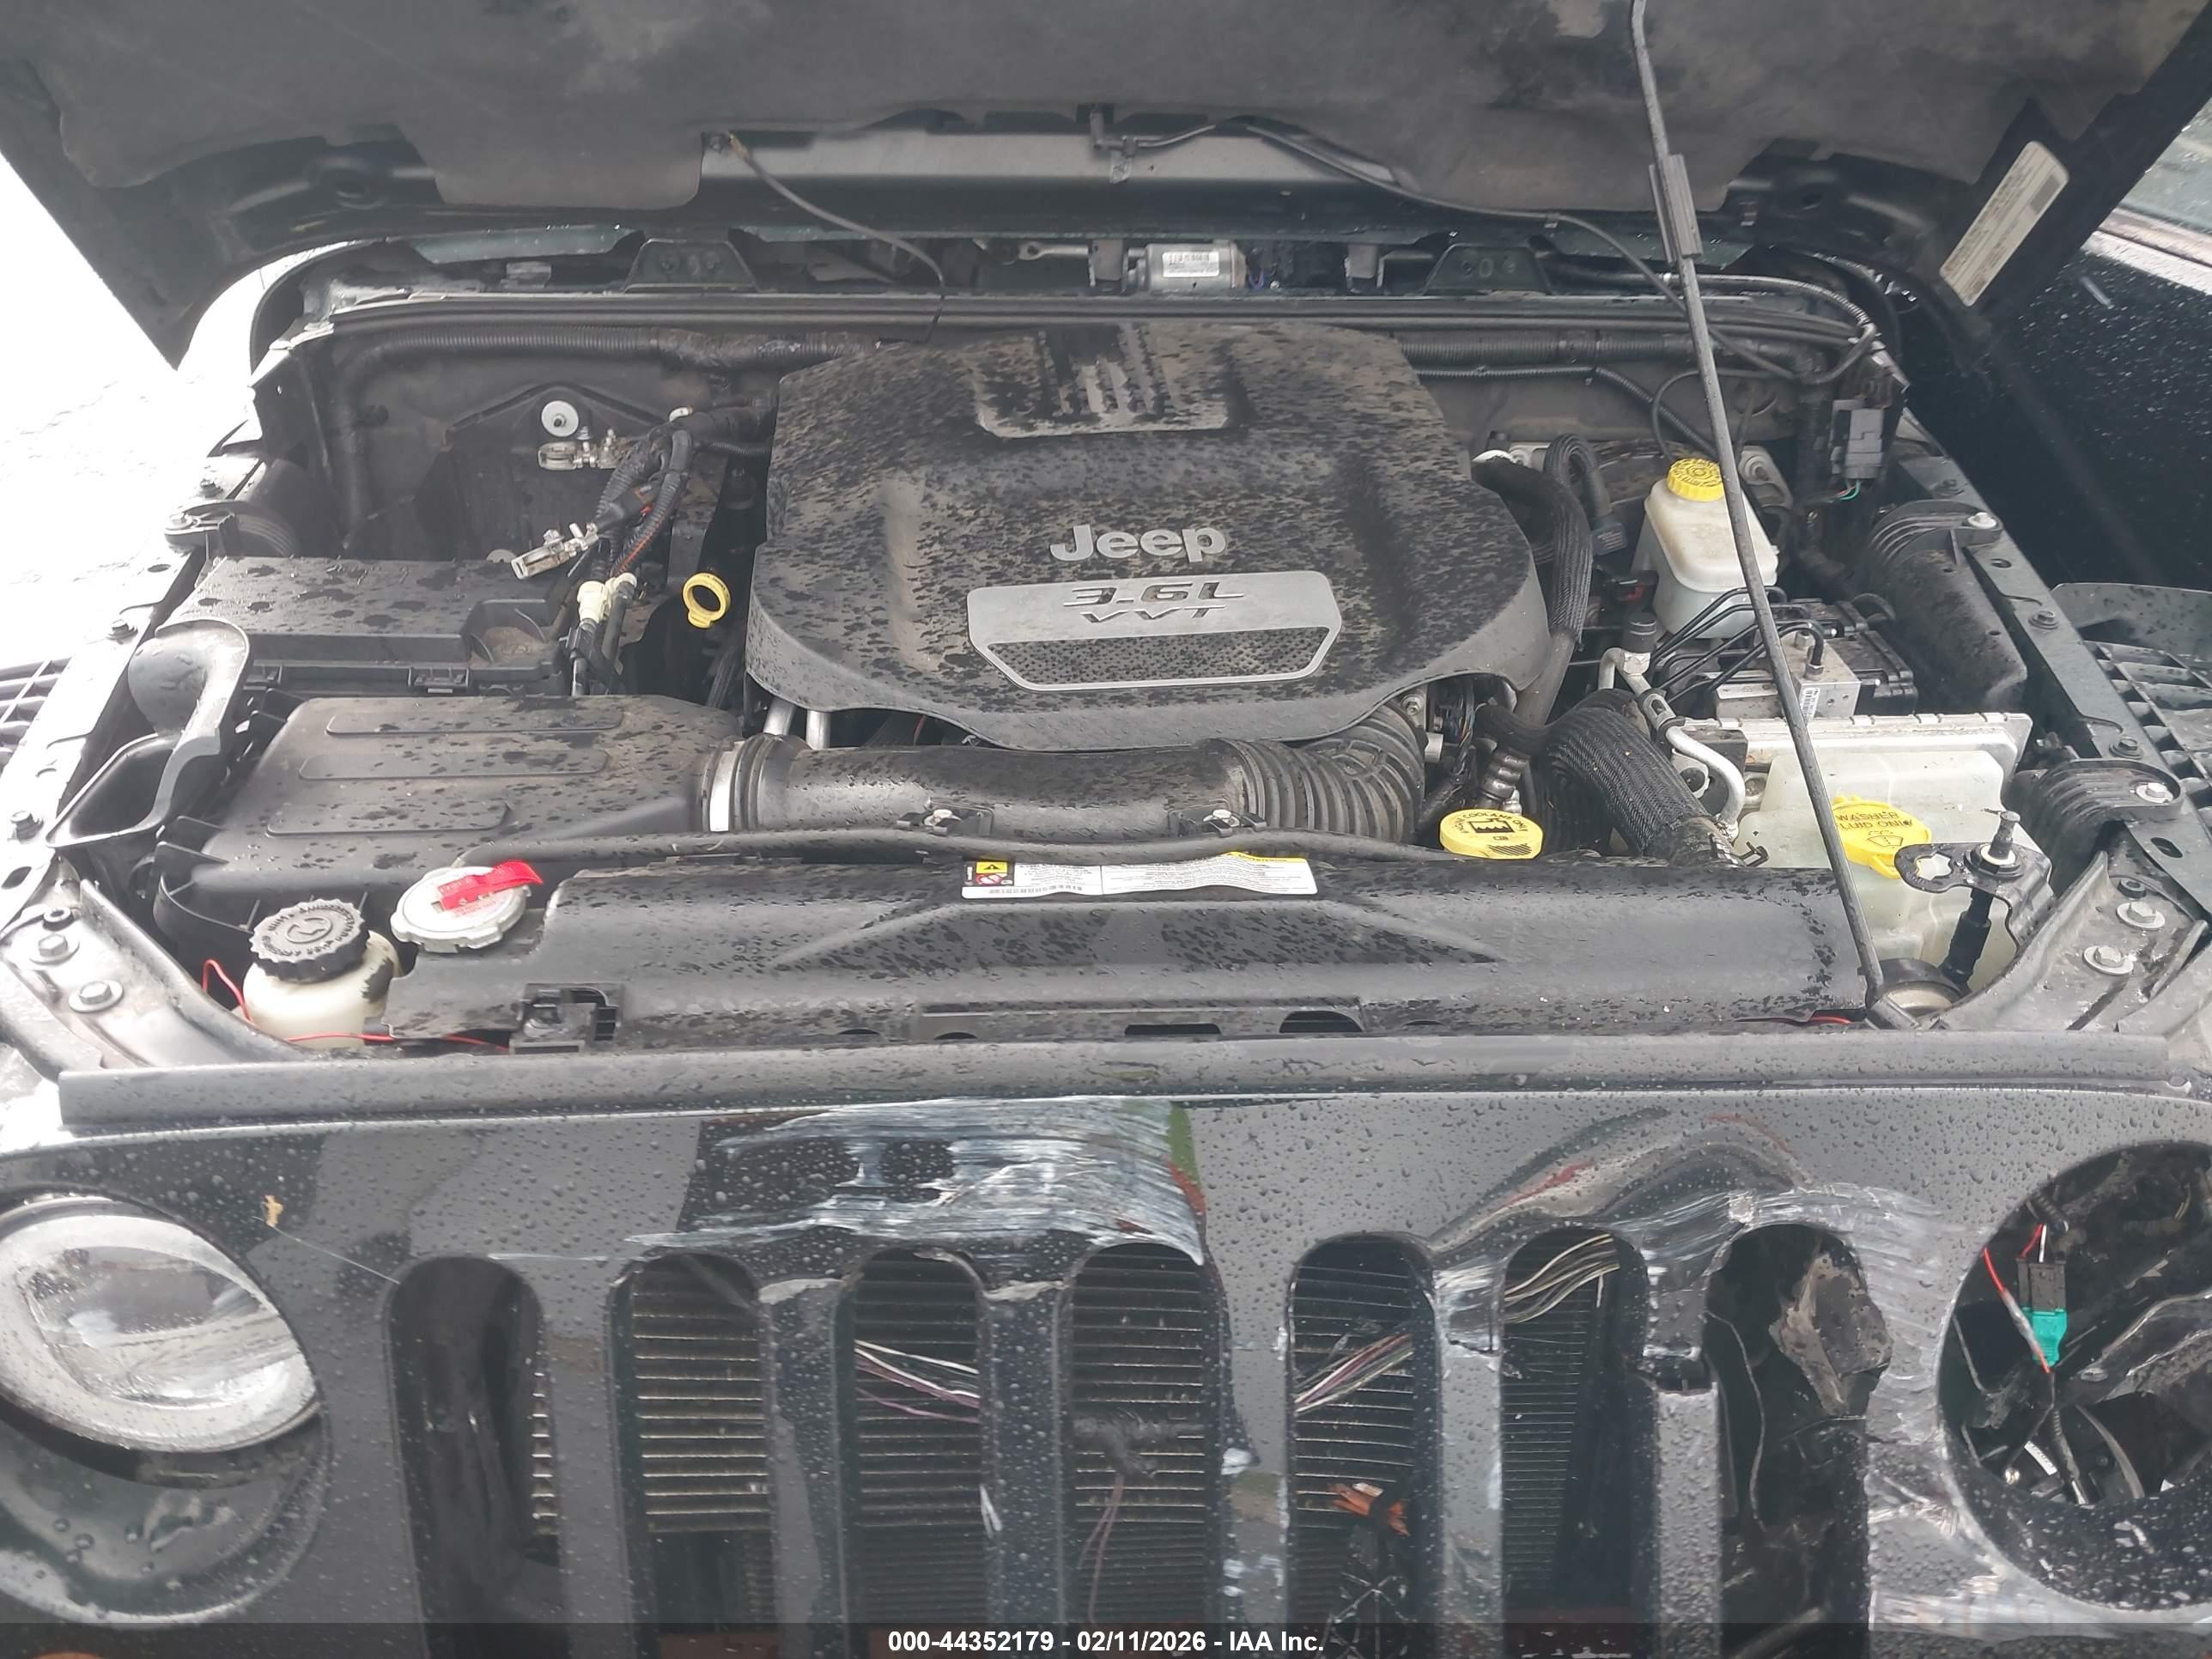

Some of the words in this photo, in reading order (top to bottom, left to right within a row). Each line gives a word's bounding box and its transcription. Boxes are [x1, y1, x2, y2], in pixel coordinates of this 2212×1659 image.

[1049, 524, 1225, 562] Jeep
[1063, 581, 1243, 606] 3.6L
[1080, 605, 1226, 623] VVT
[1835, 811, 1899, 821] WASHER
[1836, 821, 1873, 830] LUID
